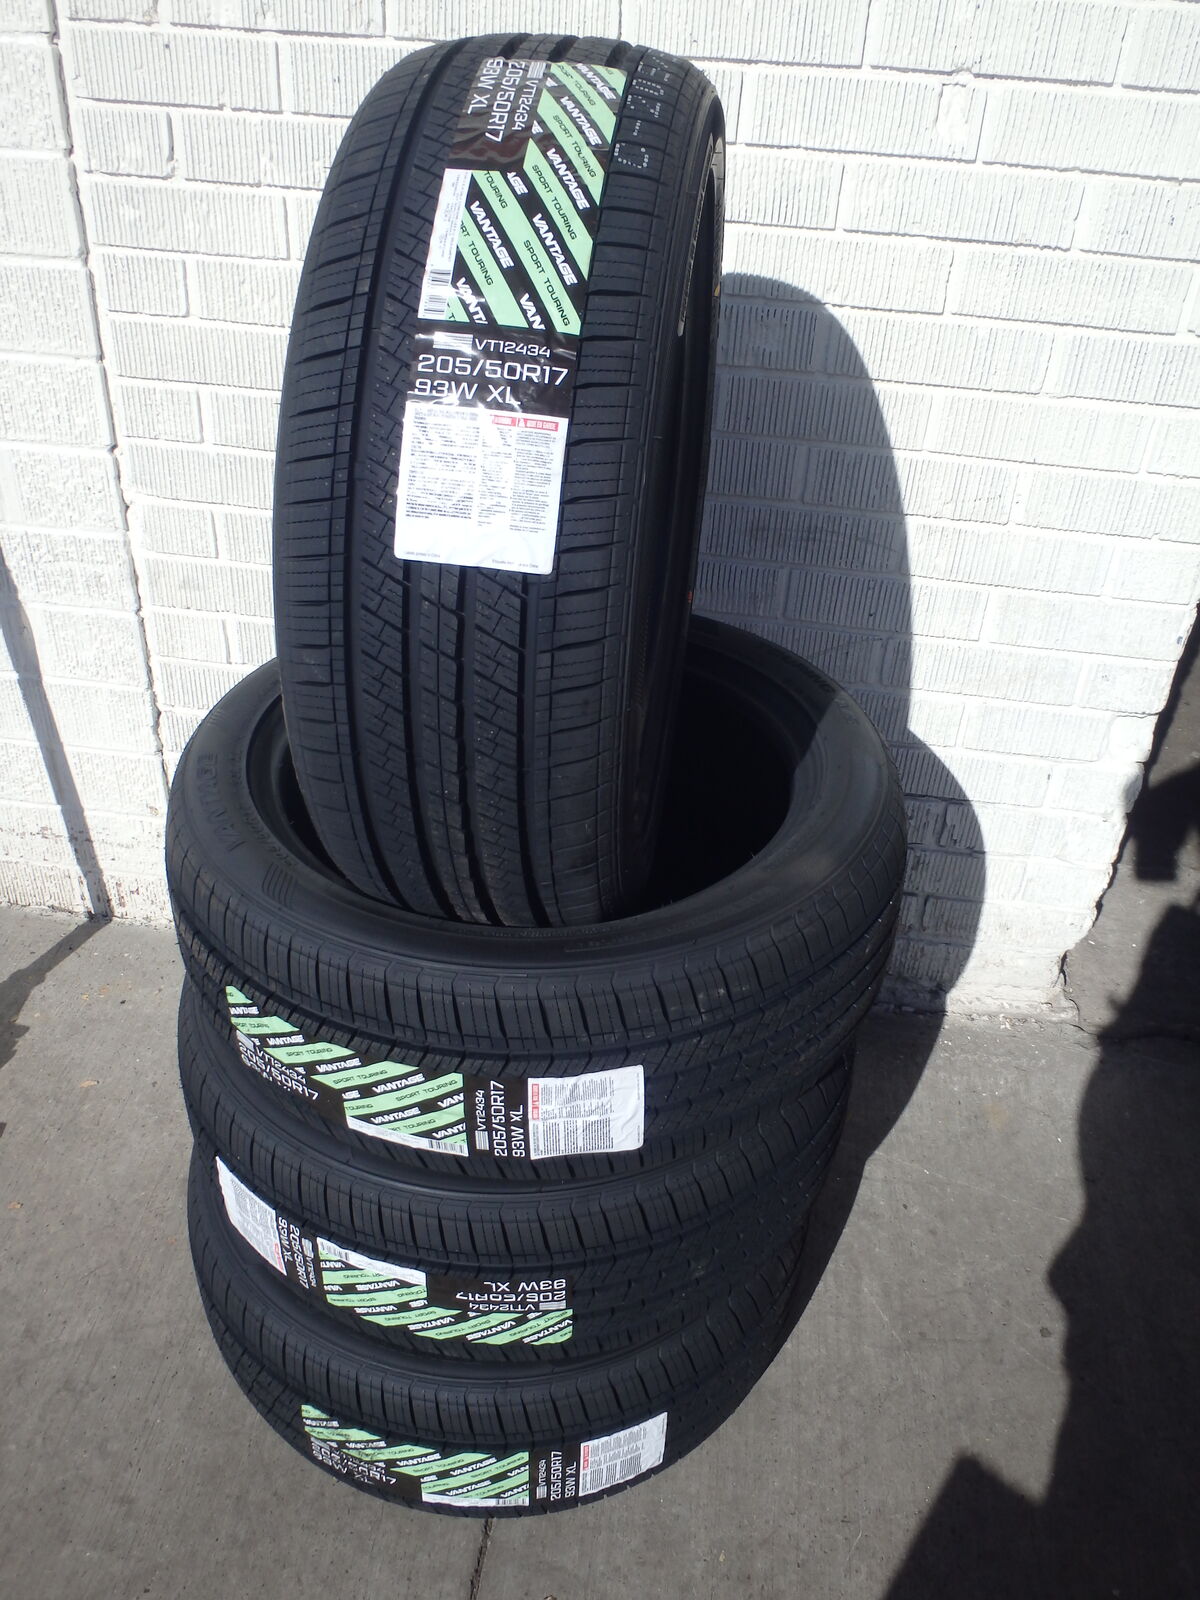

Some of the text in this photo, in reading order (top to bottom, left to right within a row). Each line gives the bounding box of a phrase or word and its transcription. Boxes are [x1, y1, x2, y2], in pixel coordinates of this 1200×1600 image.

[467, 59, 503, 114] 93W XL
[574, 79, 596, 106] TOURING
[576, 63, 616, 100] VANTAGE
[485, 61, 525, 142] 205/50R17
[560, 96, 602, 146] VANTAGE
[552, 114, 573, 139] SPORT
[571, 141, 597, 178] TOURING
[484, 170, 508, 209] TOURING
[546, 148, 590, 210] VANTAGE
[532, 164, 578, 240] SPORT TOURING
[470, 200, 514, 269] VANTAGE
[468, 240, 494, 286] TOURING
[532, 213, 578, 286] VANTAGE
[523, 240, 570, 327] SPORT TOURING
[475, 338, 550, 358] VT12434
[417, 354, 568, 386] 205/50R17
[414, 378, 521, 405] 93W XL
[266, 1034, 304, 1046] VANTAGE
[238, 1042, 318, 1100] 205/50R17
[256, 1046, 306, 1084] VT12434
[316, 1058, 362, 1072] VANTAGE
[333, 1070, 388, 1084] SPORT TOURING
[372, 1073, 426, 1094] VANTAGE
[395, 1080, 458, 1102] SPORT TOURING
[370, 1106, 421, 1124] VANTAGE
[403, 1119, 436, 1130] TOURING
[490, 1080, 508, 1157] 205/50R17
[510, 1104, 525, 1158] 93W XL
[355, 1280, 400, 1291] VANTAGE
[456, 1290, 566, 1302] 205/50R17
[484, 1278, 566, 1292] 93W XL
[354, 1304, 398, 1314] VANTAGE
[469, 1302, 536, 1312] VT12434
[408, 1316, 456, 1330] VANTAGE
[466, 1320, 516, 1340] VANTAGE
[508, 1323, 542, 1337] TOURING
[522, 1319, 573, 1344] VANTAGE
[396, 1453, 442, 1466] VANTAGE
[450, 1456, 498, 1476] VANTAGE
[446, 1480, 492, 1496] VANTAGE
[550, 1451, 562, 1501] 205/50R17
[564, 1461, 577, 1498] 93W XL
